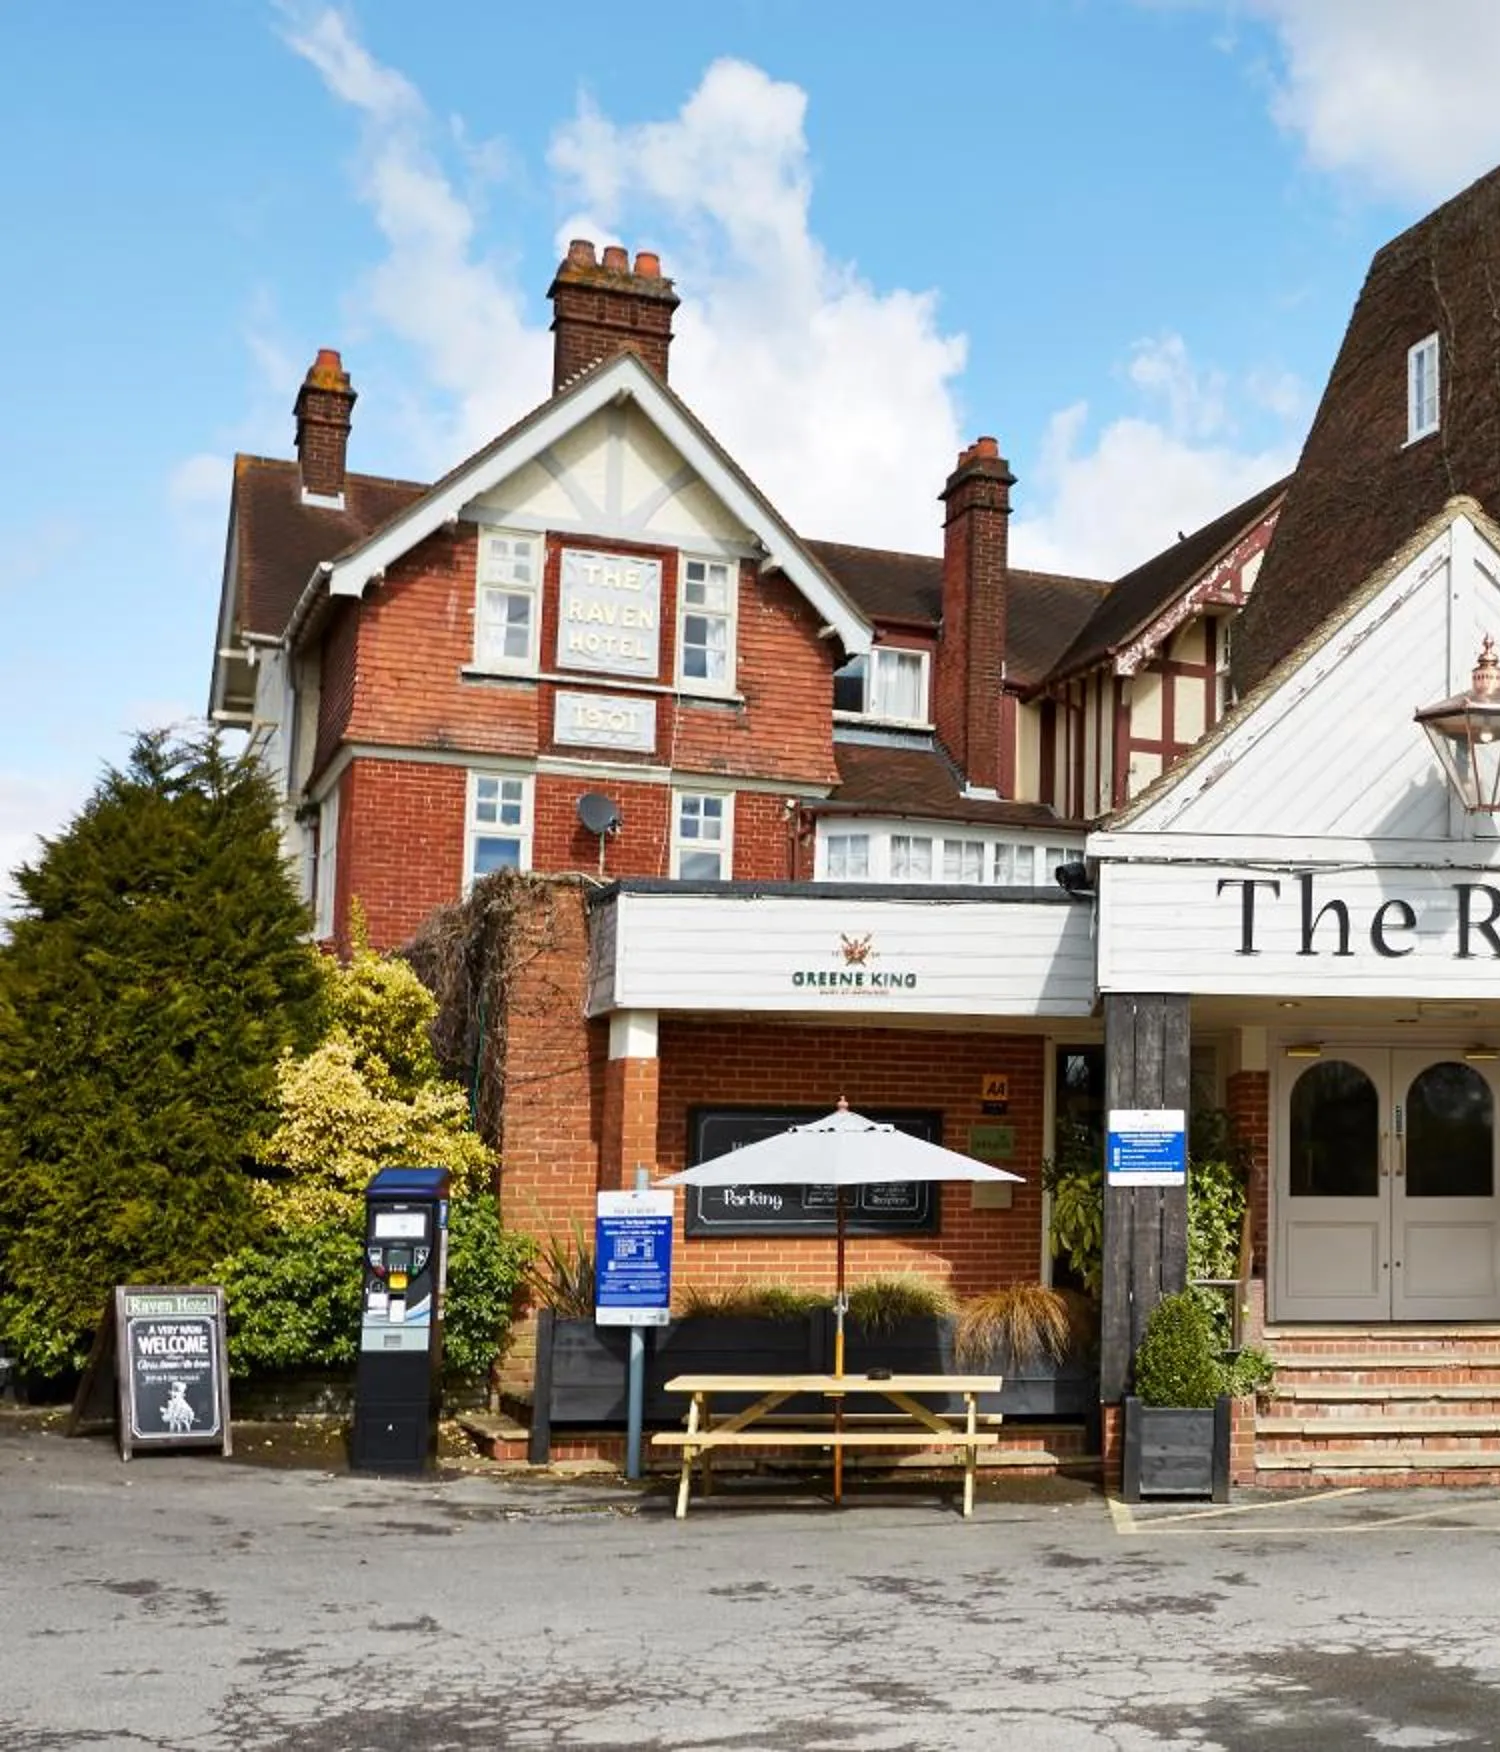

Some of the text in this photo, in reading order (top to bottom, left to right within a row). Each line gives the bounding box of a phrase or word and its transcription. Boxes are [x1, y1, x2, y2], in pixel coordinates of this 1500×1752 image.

[583, 564, 641, 591] THE
[568, 597, 654, 630] RAVEN
[568, 632, 650, 660] HOTEL
[1217, 873, 1418, 958] The
[792, 971, 917, 988] GREENE KING
[723, 1188, 783, 1211] Parking
[137, 1335, 209, 1354] WELCOME
